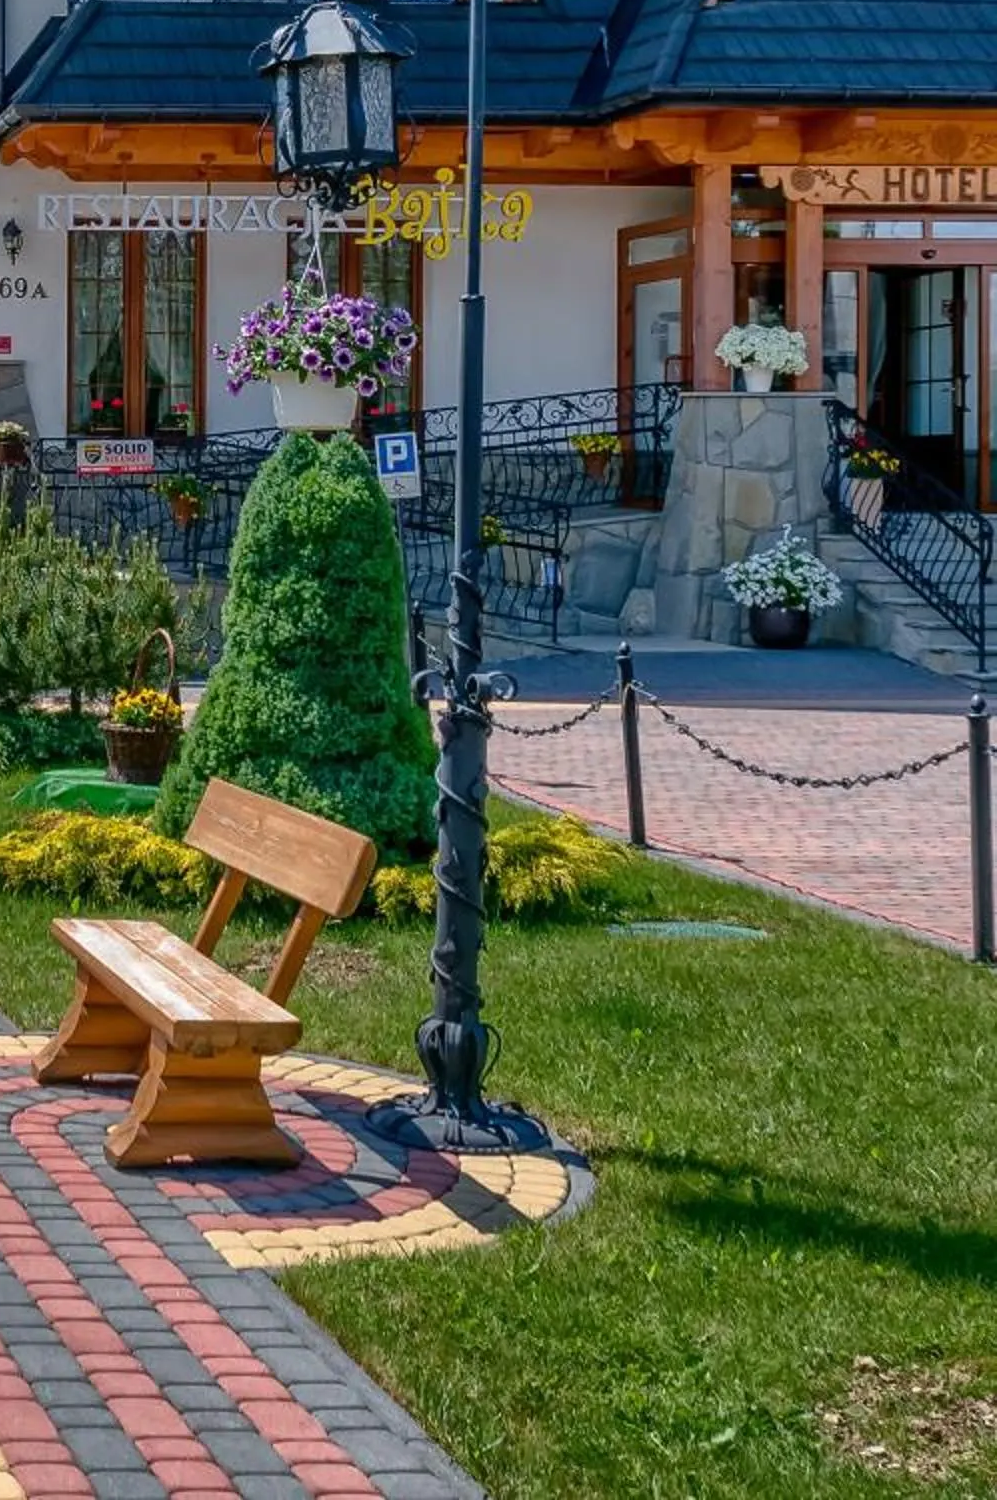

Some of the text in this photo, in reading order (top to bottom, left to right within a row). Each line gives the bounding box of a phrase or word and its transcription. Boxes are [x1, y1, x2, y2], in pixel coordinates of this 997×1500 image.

[883, 167, 997, 202] HOTEL
[104, 443, 147, 455] SOLID
[386, 439, 408, 471] P
